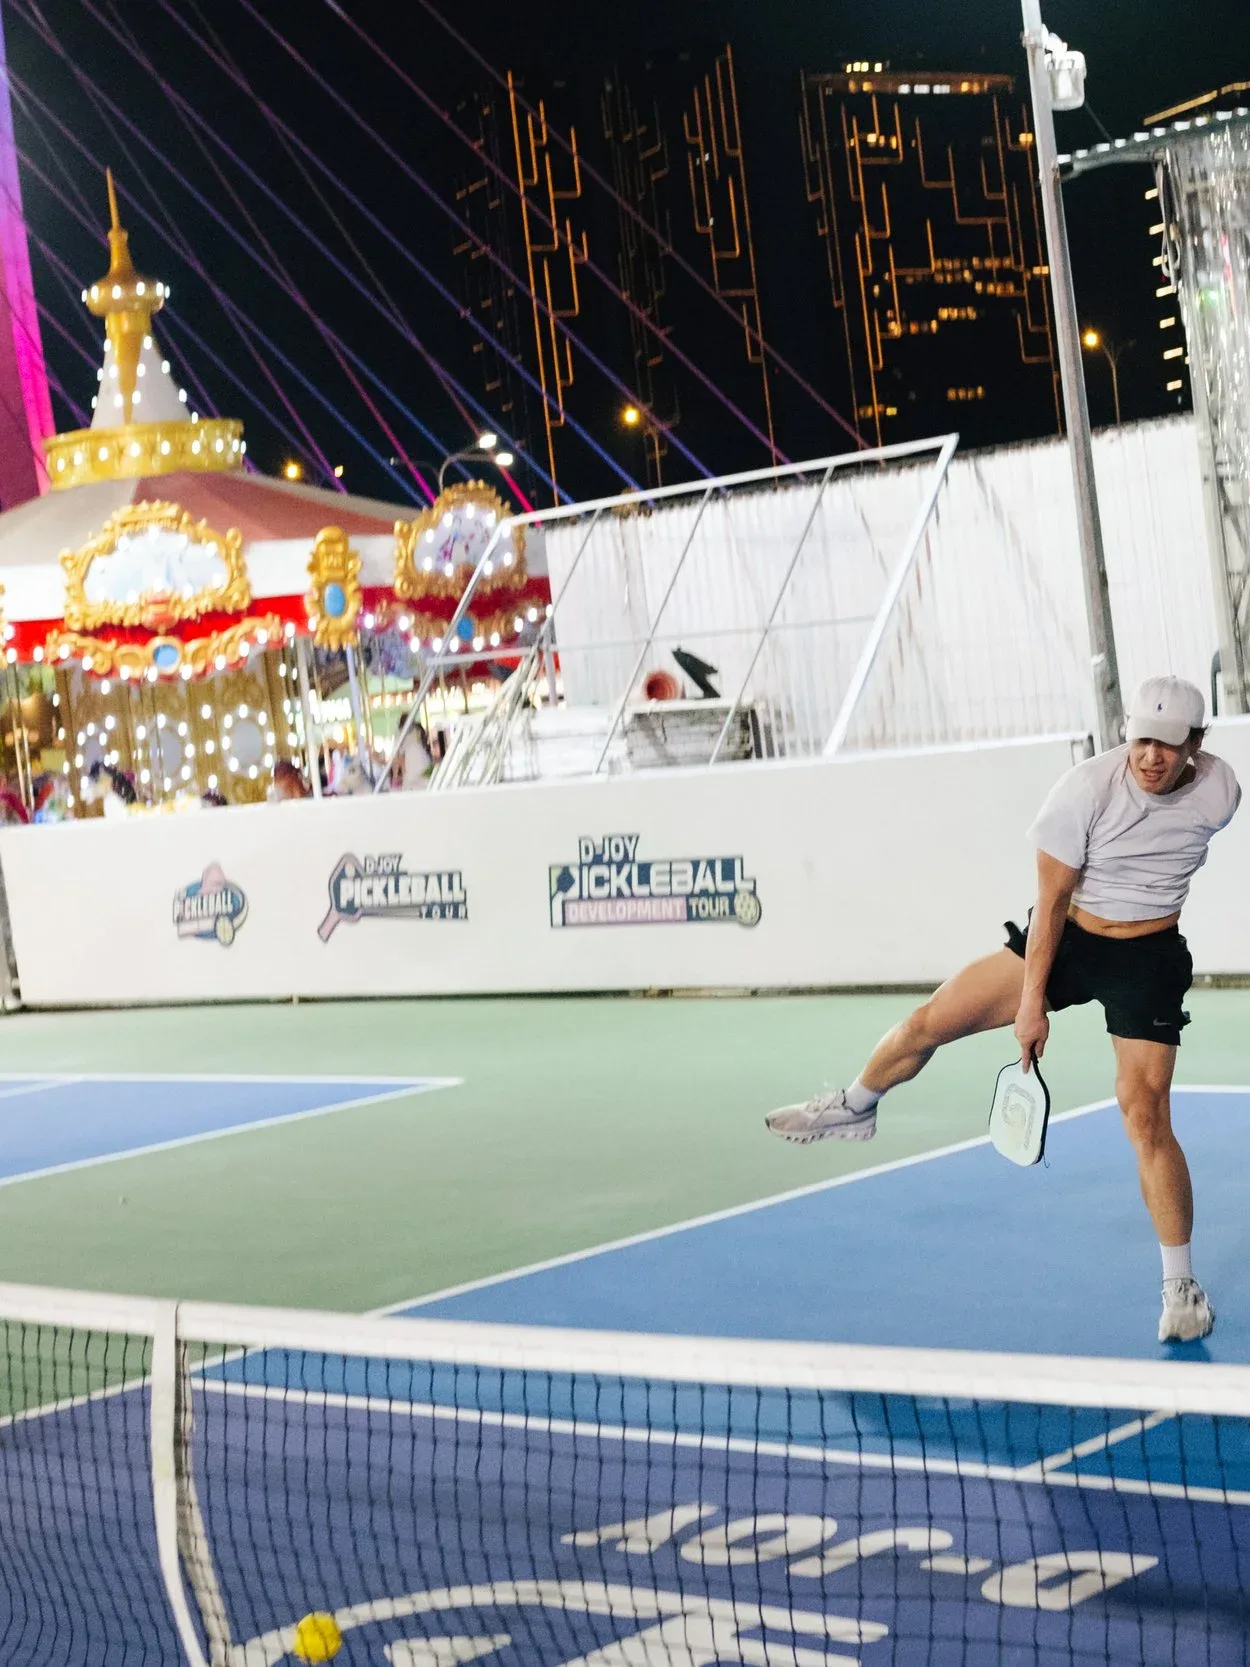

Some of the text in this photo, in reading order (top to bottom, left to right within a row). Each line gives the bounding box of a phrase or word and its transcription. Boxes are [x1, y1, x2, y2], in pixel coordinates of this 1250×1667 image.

[579, 833, 640, 863] D-JOY
[364, 852, 403, 873] D-JOY
[339, 871, 467, 909] PICKLEBALL
[549, 856, 756, 927] PICKLEBALL
[418, 904, 469, 920] TOUR
[568, 896, 729, 922] DEVELOPMENT TOUR
